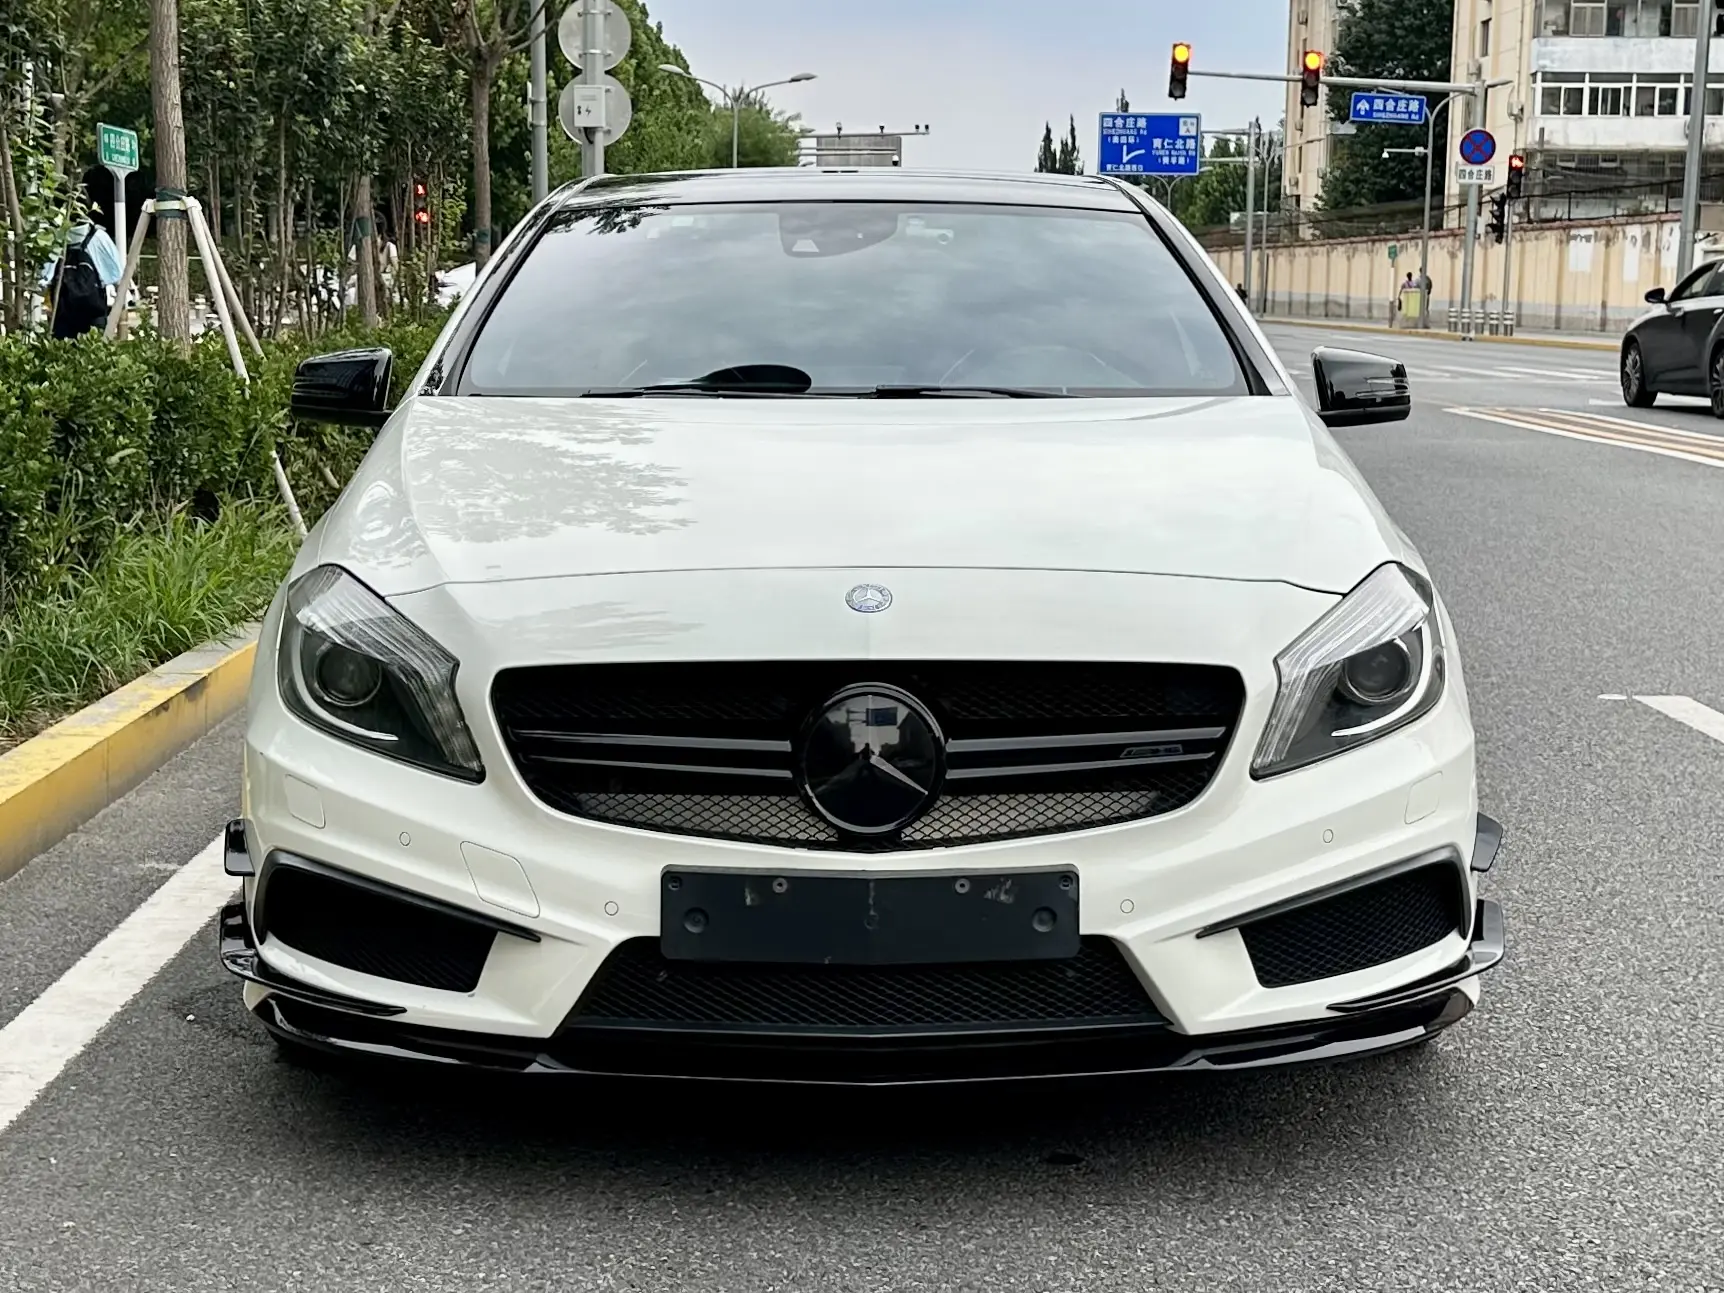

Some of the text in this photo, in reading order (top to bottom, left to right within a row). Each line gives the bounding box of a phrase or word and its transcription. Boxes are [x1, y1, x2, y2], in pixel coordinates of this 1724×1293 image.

[1372, 98, 1420, 112] 四合庄路
[1103, 117, 1147, 128] 四合庄路
[1458, 168, 1492, 180] 四合庄路
